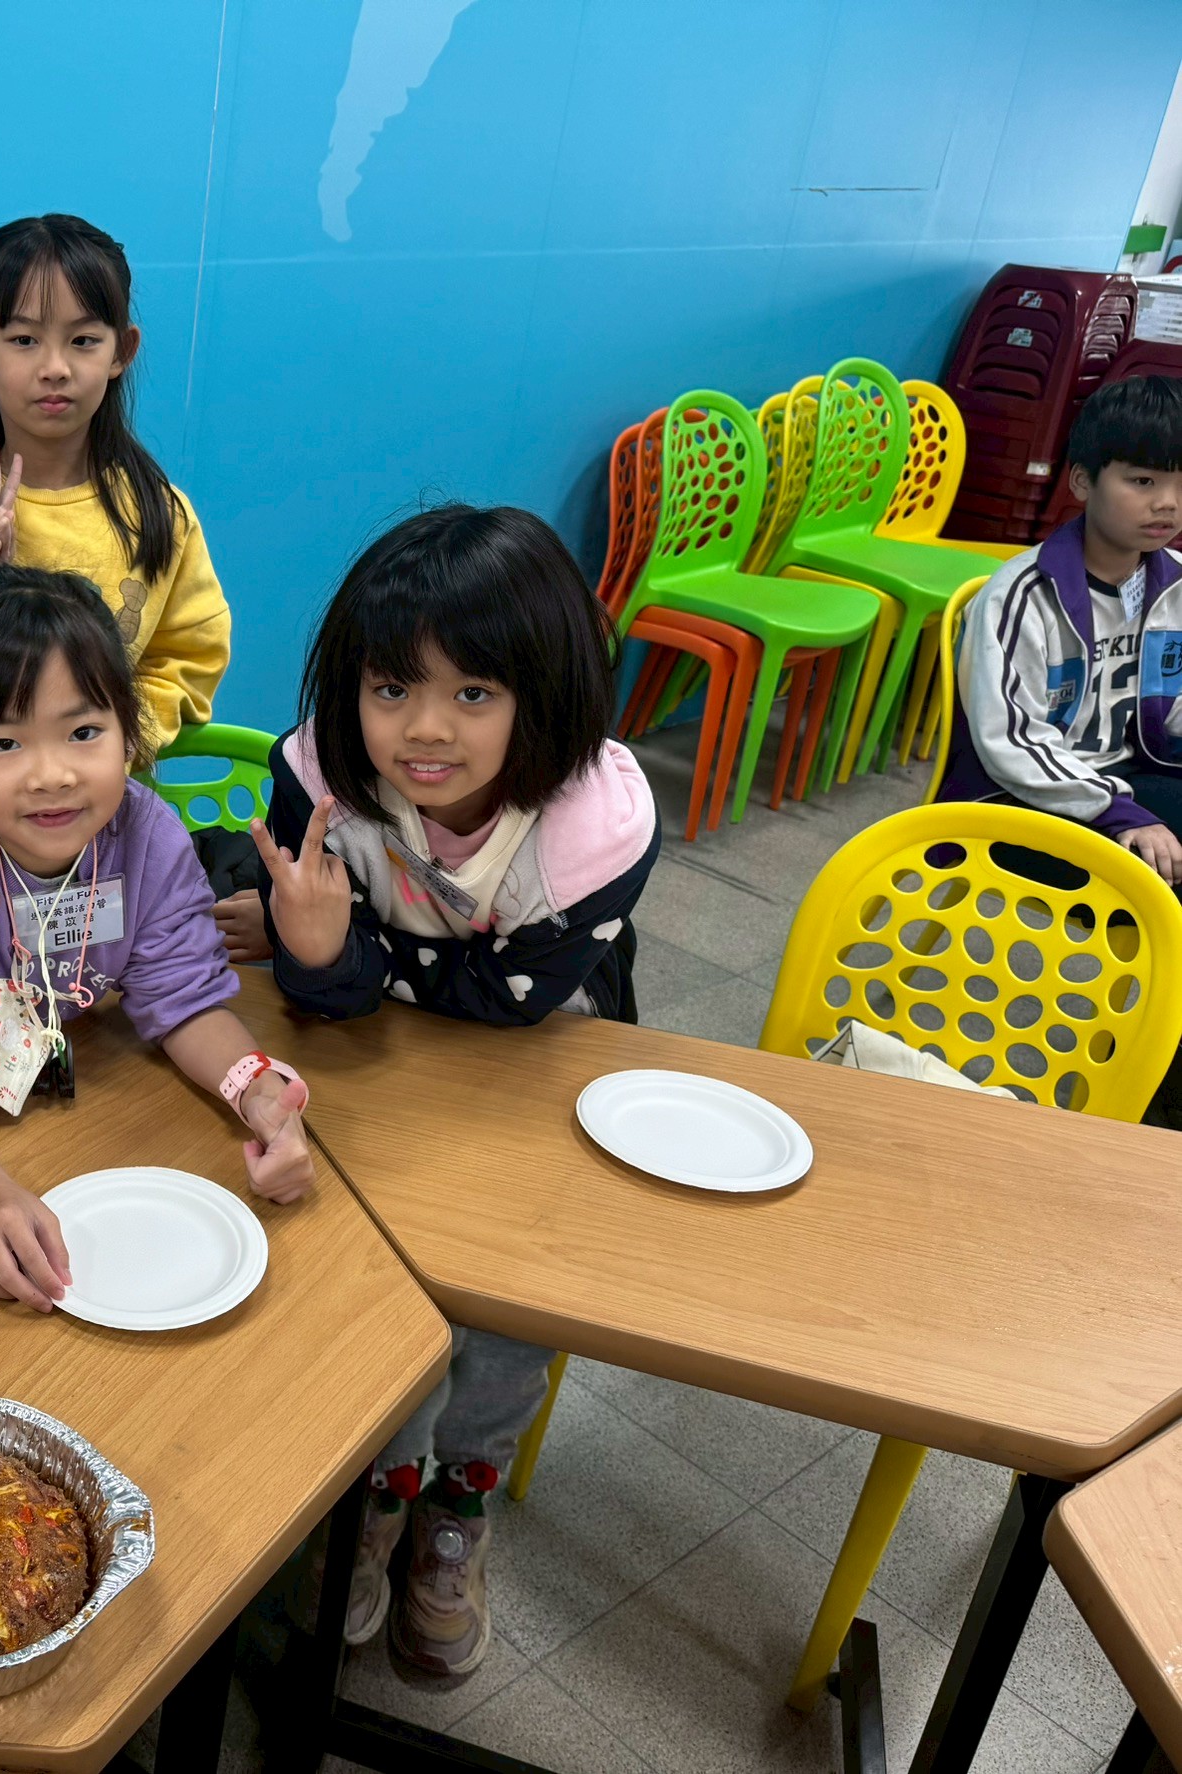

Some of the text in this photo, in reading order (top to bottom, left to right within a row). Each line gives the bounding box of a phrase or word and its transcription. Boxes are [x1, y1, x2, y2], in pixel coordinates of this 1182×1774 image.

[36, 897, 54, 907] Fit
[77, 888, 99, 899] Fun
[55, 929, 93, 946] Ellie
